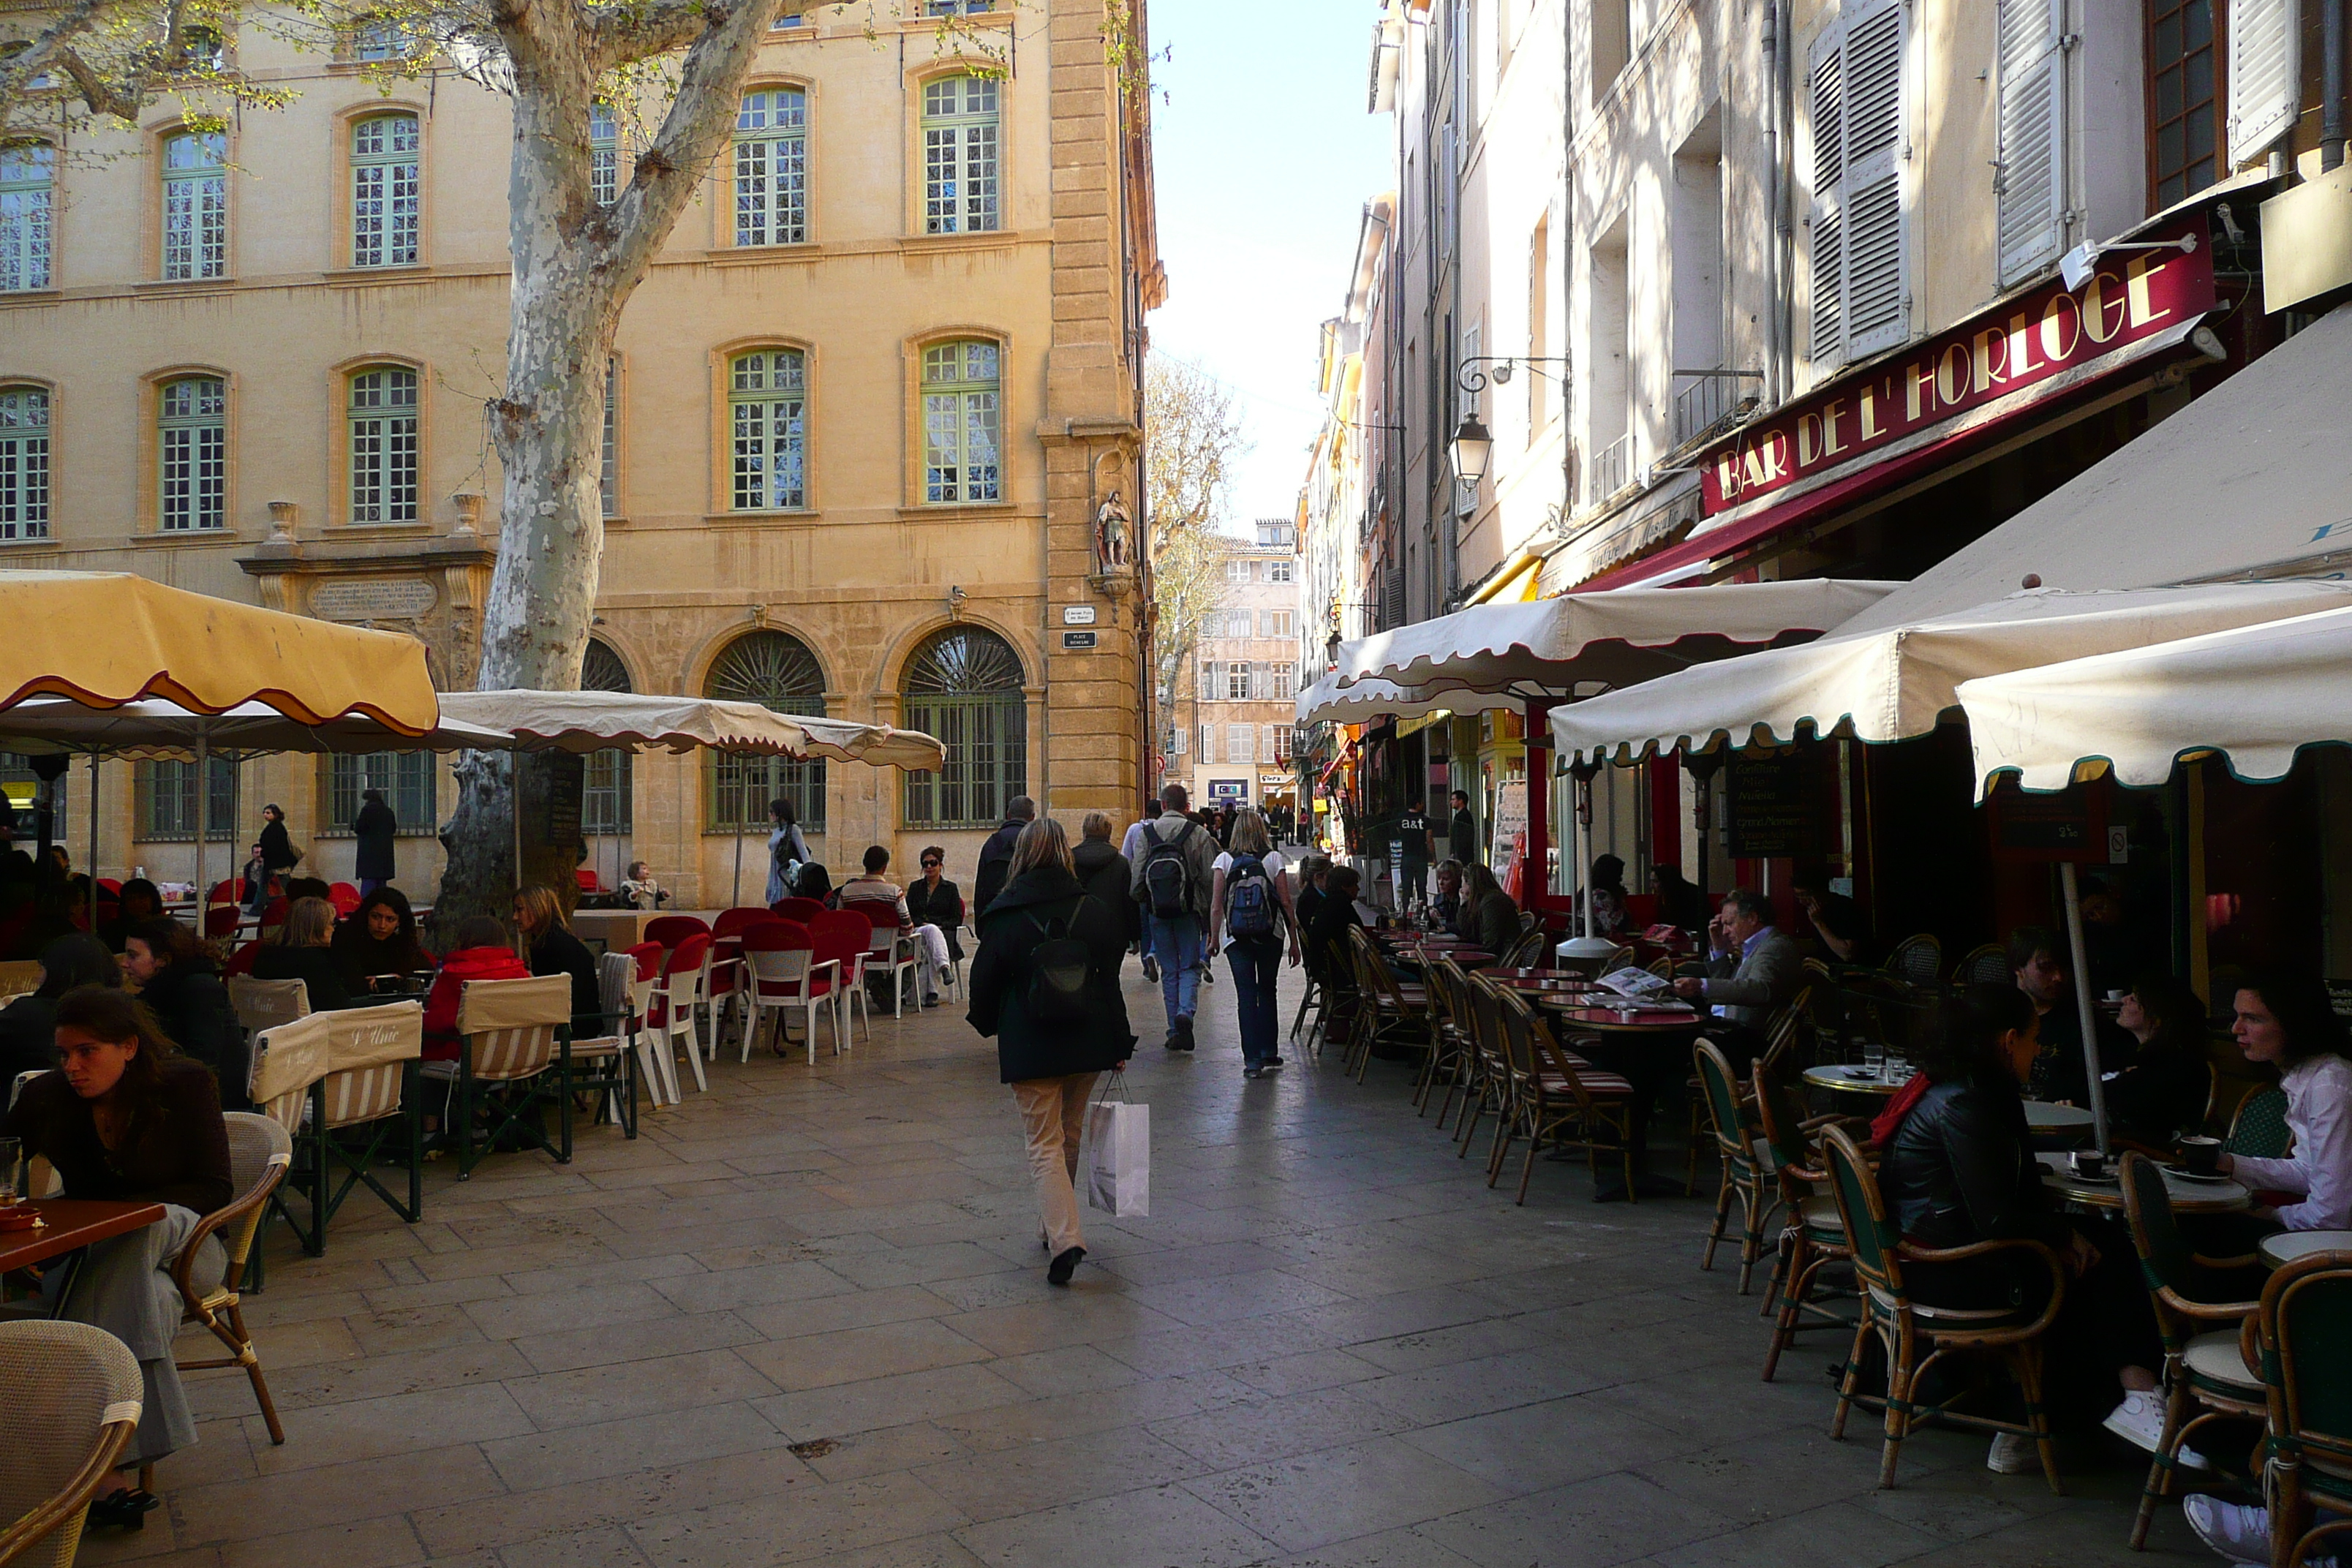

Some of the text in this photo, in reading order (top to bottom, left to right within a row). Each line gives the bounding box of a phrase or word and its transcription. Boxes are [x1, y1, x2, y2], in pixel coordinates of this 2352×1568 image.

[1719, 428, 1787, 501] BAR
[1798, 397, 1849, 468] DE
[1401, 818, 1424, 829] a&t
